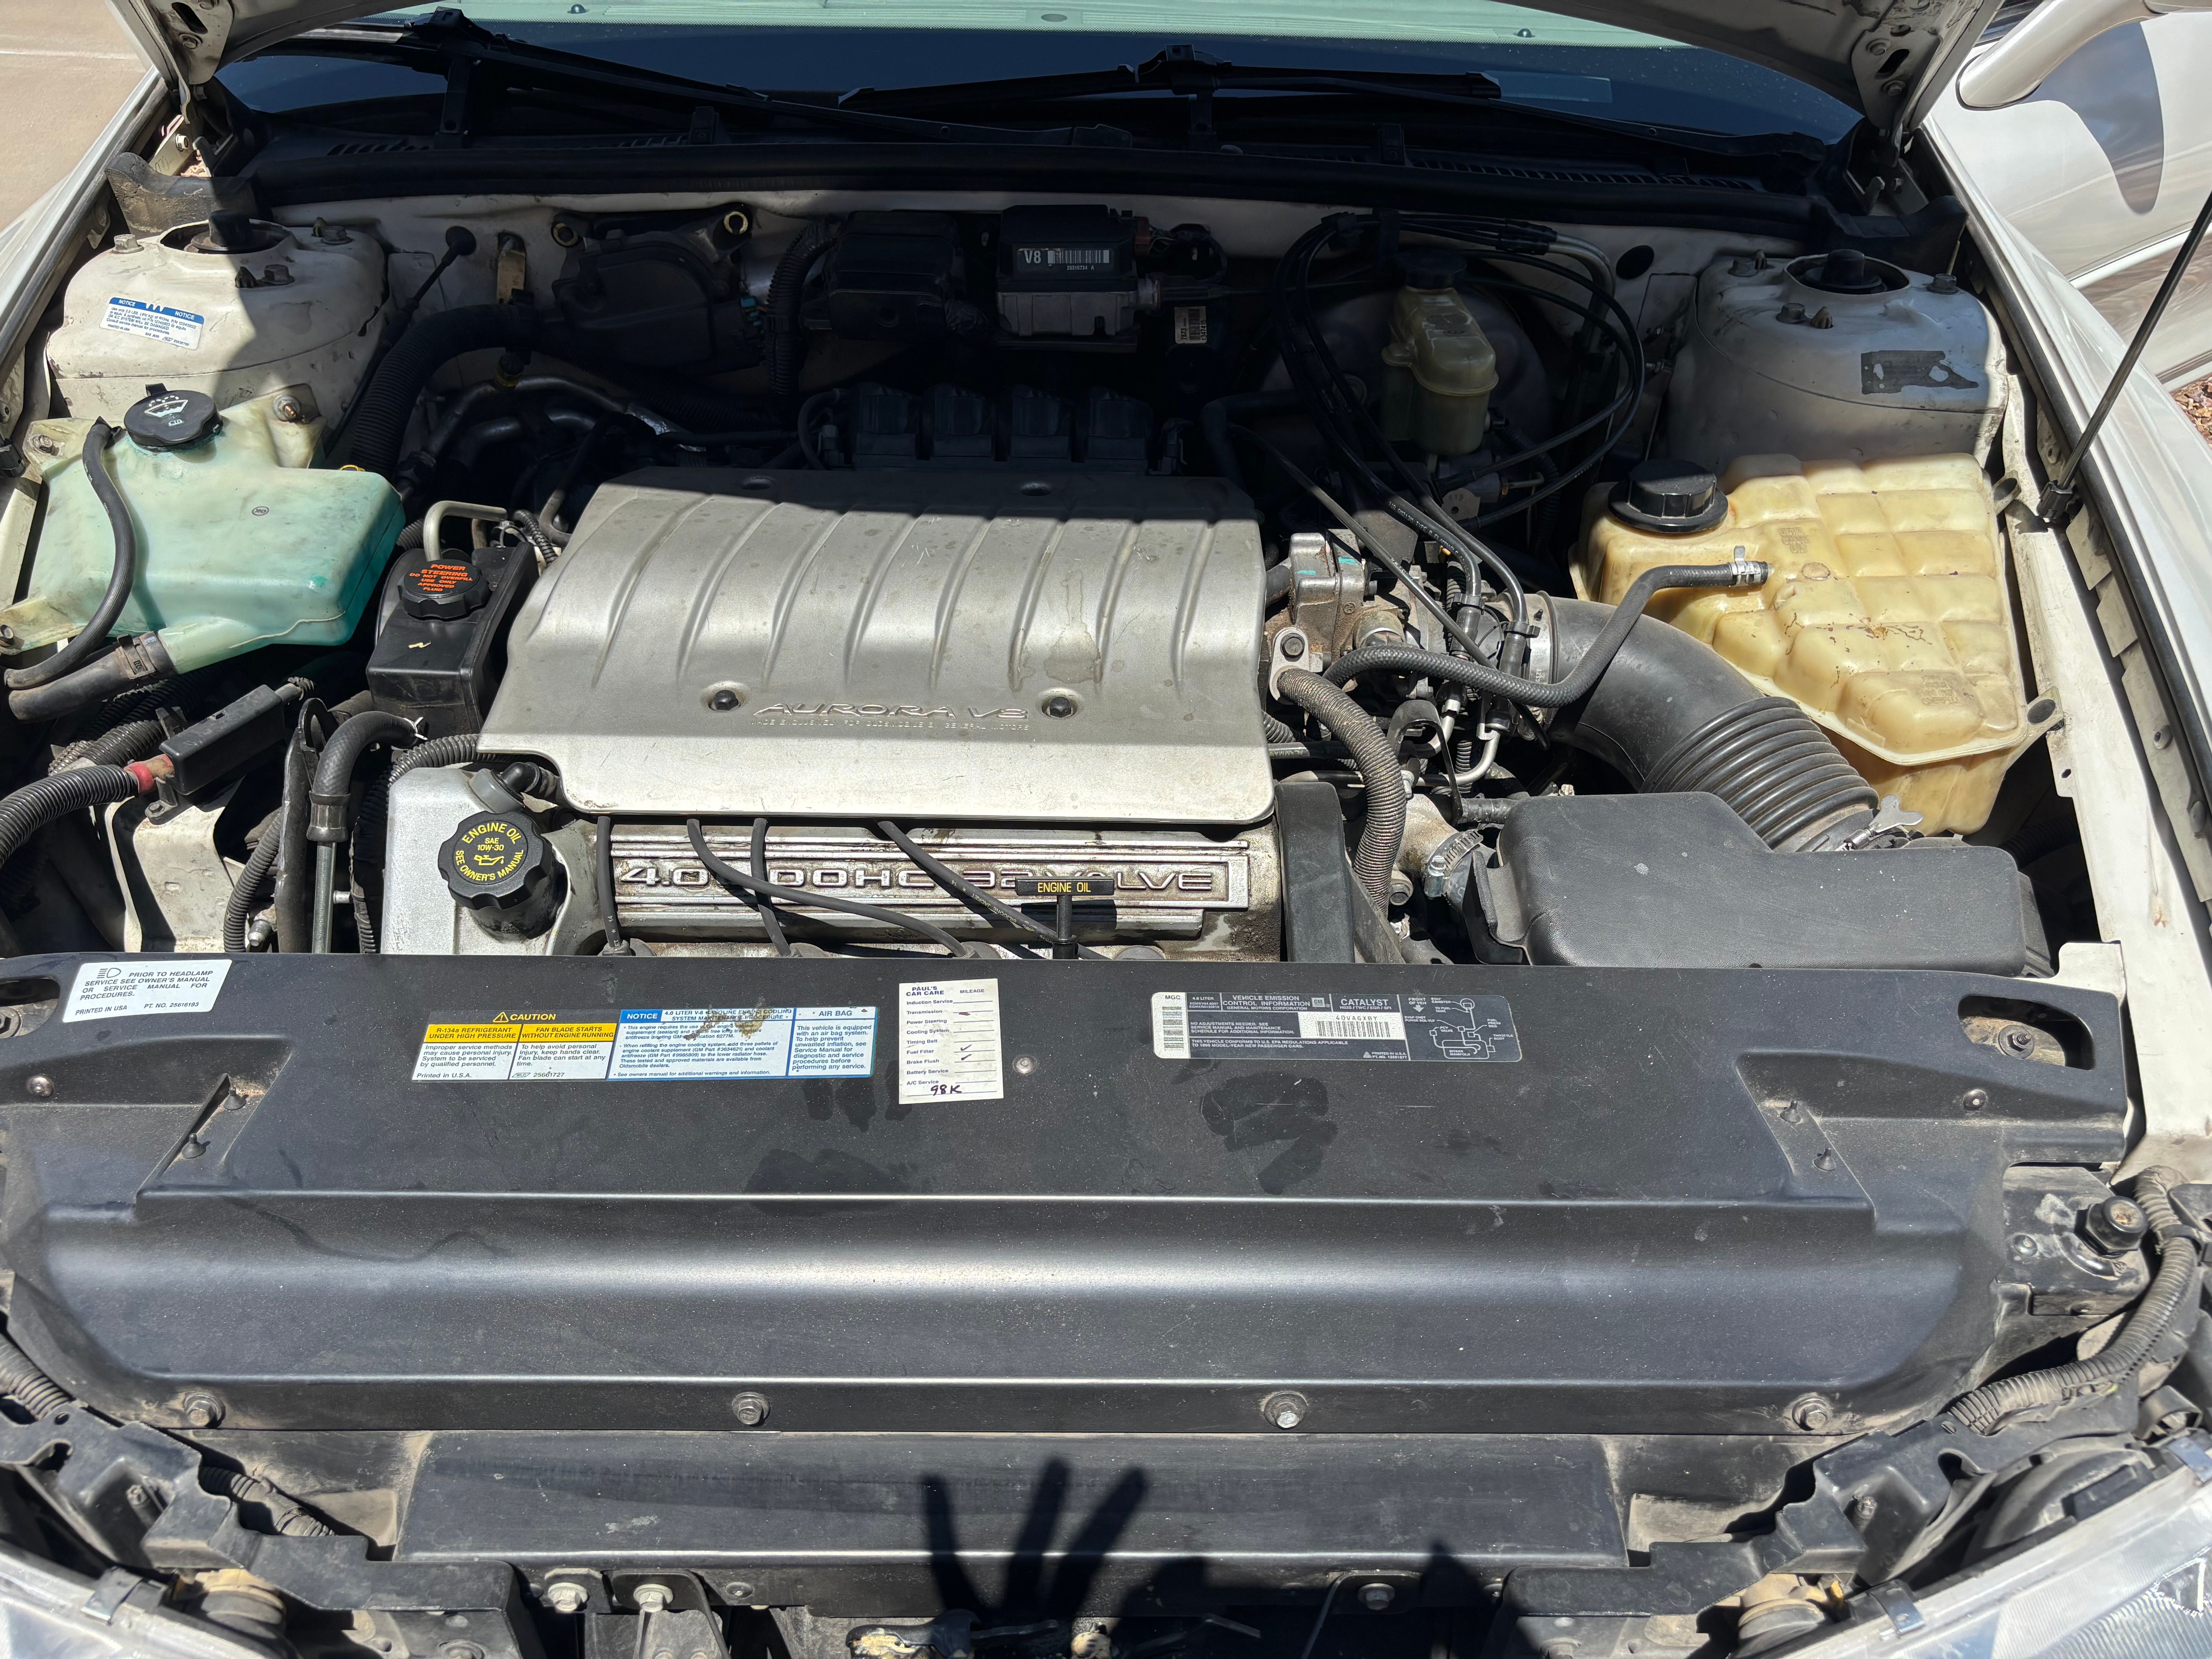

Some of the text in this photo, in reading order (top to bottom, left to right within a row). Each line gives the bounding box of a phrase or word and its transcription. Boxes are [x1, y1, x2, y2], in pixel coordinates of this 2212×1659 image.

[1024, 251, 1041, 263] V8
[175, 311, 195, 319] NOTICE
[753, 703, 1029, 720] AURORA V8
[462, 823, 522, 844] ENGINE OIL
[455, 850, 524, 881] SEE OWNER'S MANUAL
[620, 867, 711, 886] 4.0
[768, 869, 936, 888] DOHC
[1037, 882, 1091, 893] ENGINE OIL
[972, 893, 1017, 923] SILICONE JACKET
[80, 991, 135, 1000] PROCEDURES.
[75, 1007, 103, 1015] PRINTED
